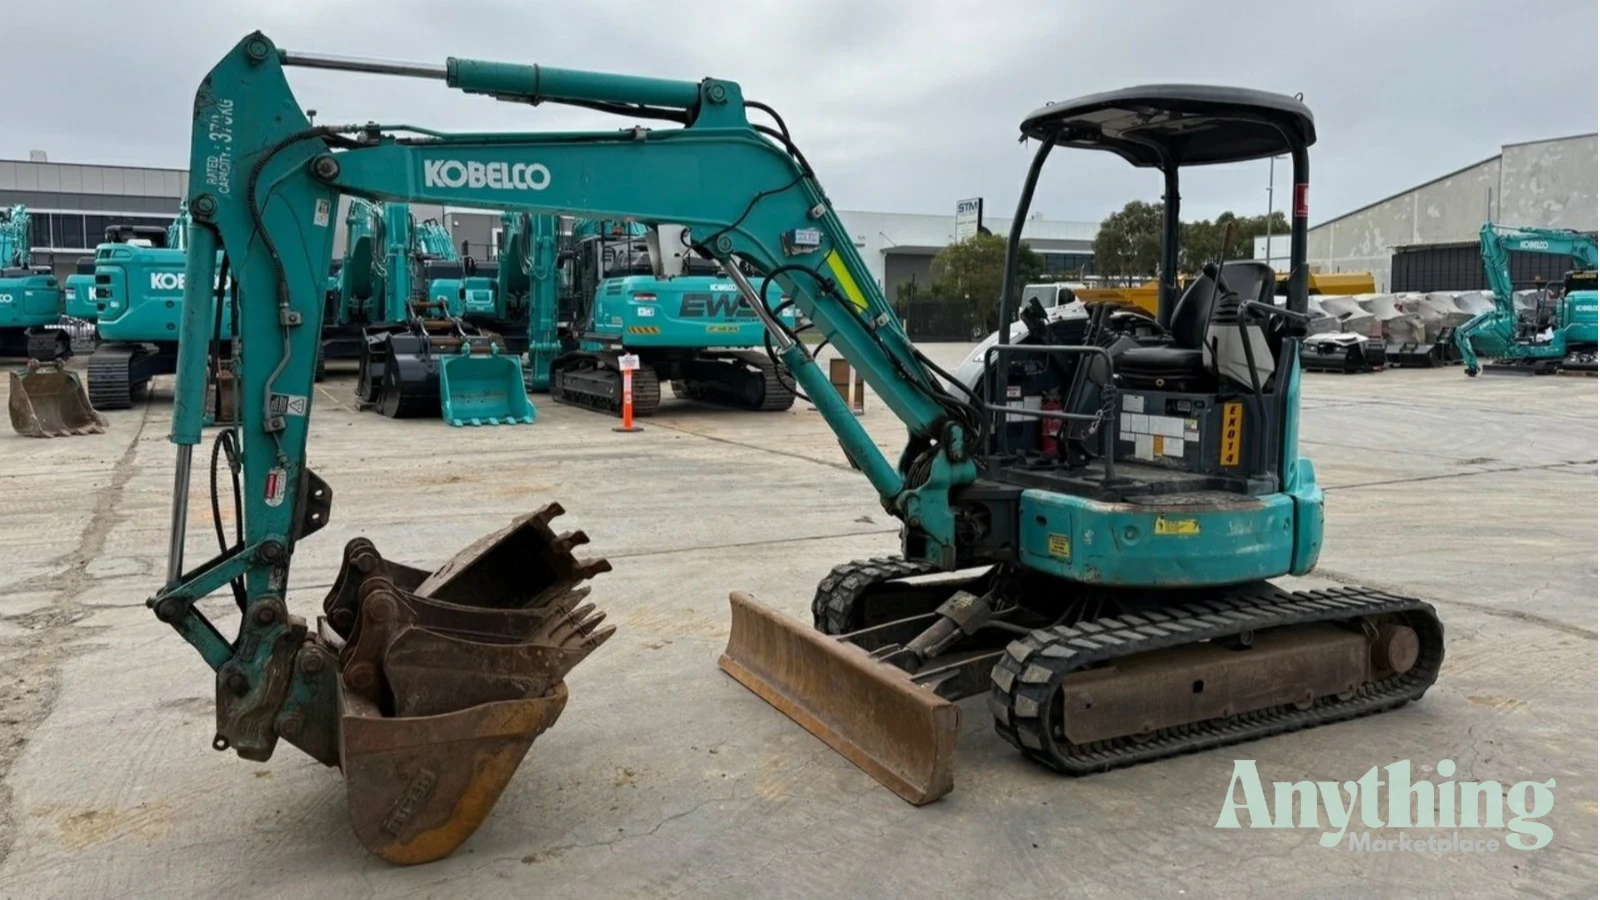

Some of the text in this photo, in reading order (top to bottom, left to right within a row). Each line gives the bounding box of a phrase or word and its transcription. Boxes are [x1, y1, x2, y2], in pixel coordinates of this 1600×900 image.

[207, 156, 219, 185] RATED
[218, 152, 232, 194] CAPACITY
[424, 159, 551, 190] KOBELCO
[1520, 241, 1549, 250] KOBELCO
[1226, 406, 1237, 463] EX014
